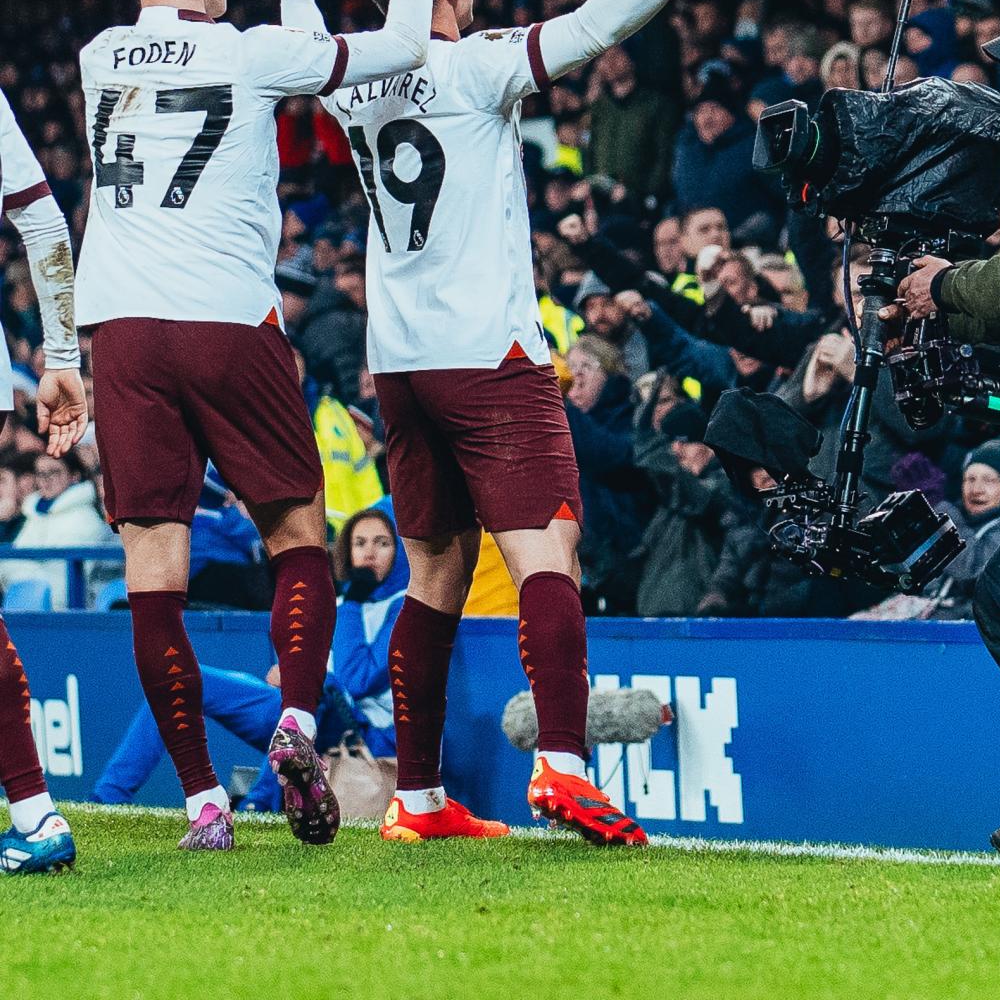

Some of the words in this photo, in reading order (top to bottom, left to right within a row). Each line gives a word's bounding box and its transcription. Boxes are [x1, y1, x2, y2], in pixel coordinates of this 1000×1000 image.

[113, 41, 197, 70] FODEN
[92, 84, 234, 209] 47
[347, 118, 446, 253] 19
[534, 673, 744, 824] ICK
